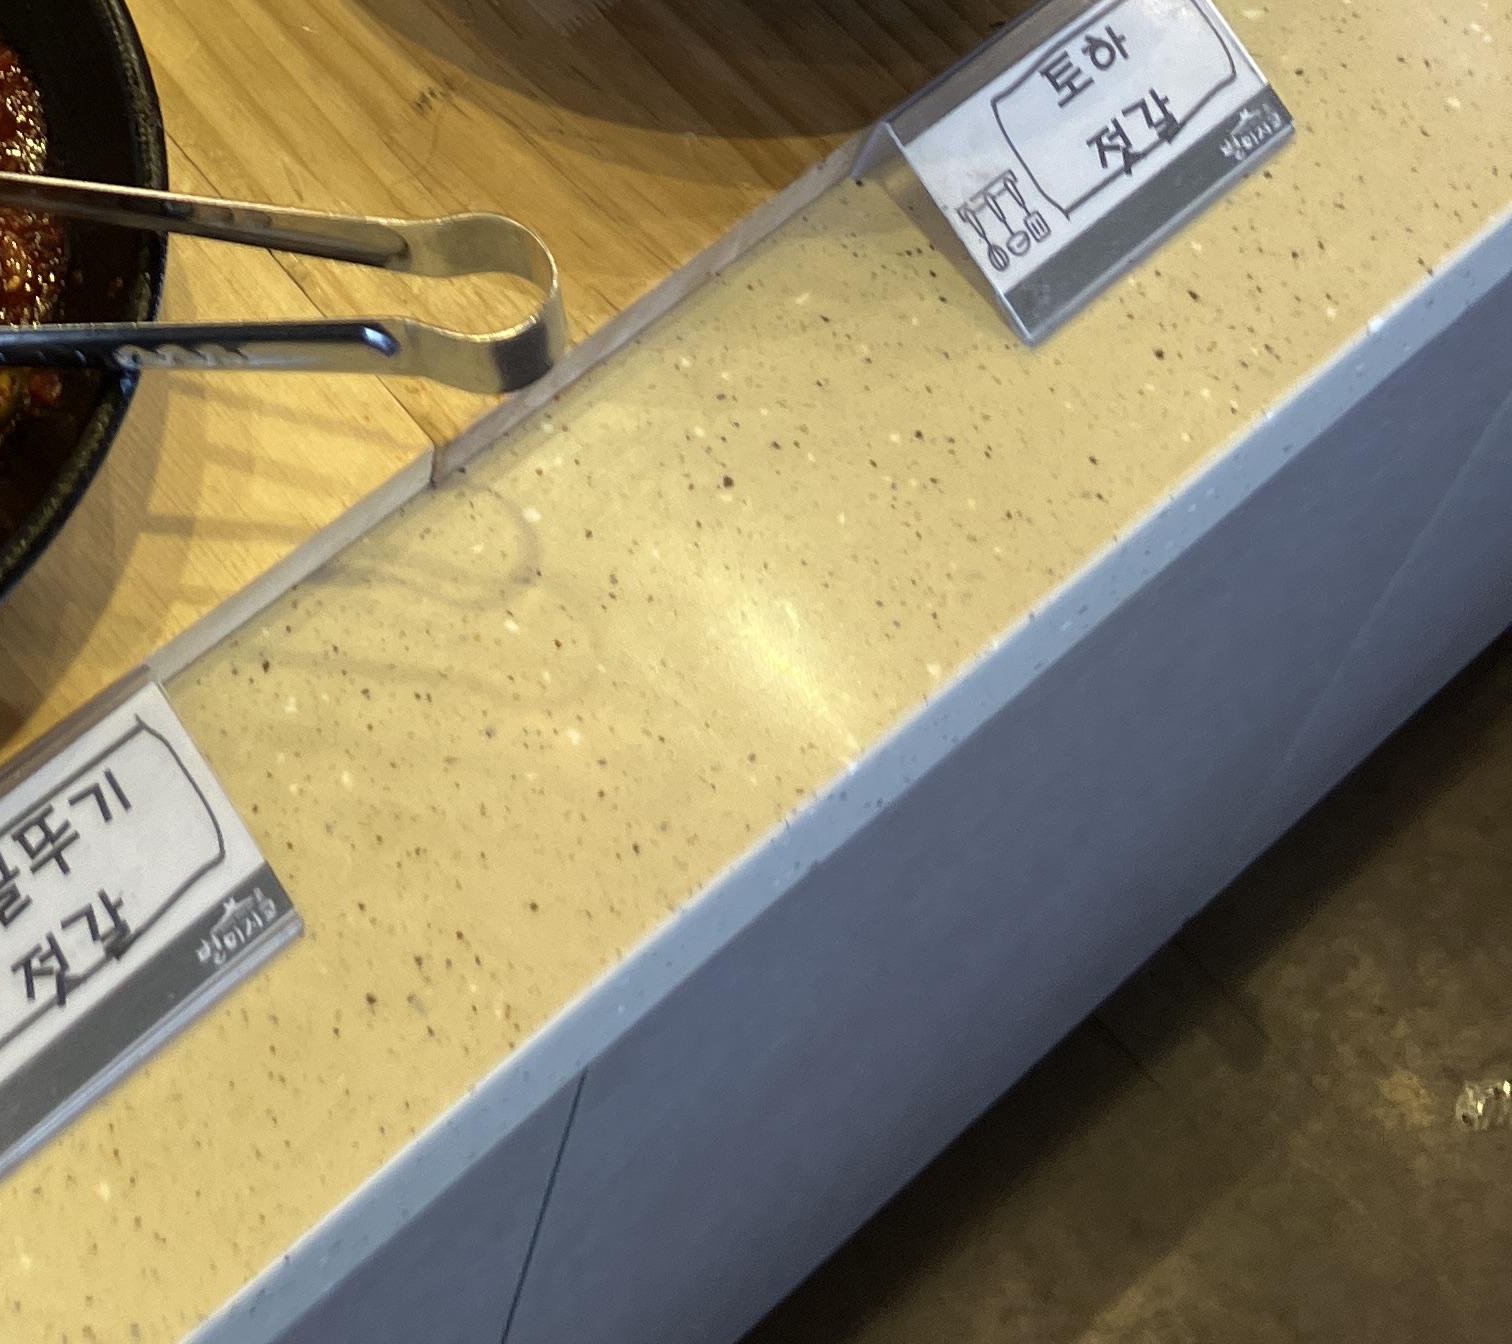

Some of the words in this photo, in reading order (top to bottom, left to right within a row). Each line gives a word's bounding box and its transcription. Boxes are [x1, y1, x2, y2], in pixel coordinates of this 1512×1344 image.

[1039, 24, 1131, 108] 토하
[1086, 88, 1180, 176] 젓갈
[11, 888, 130, 1007] 젓갈
